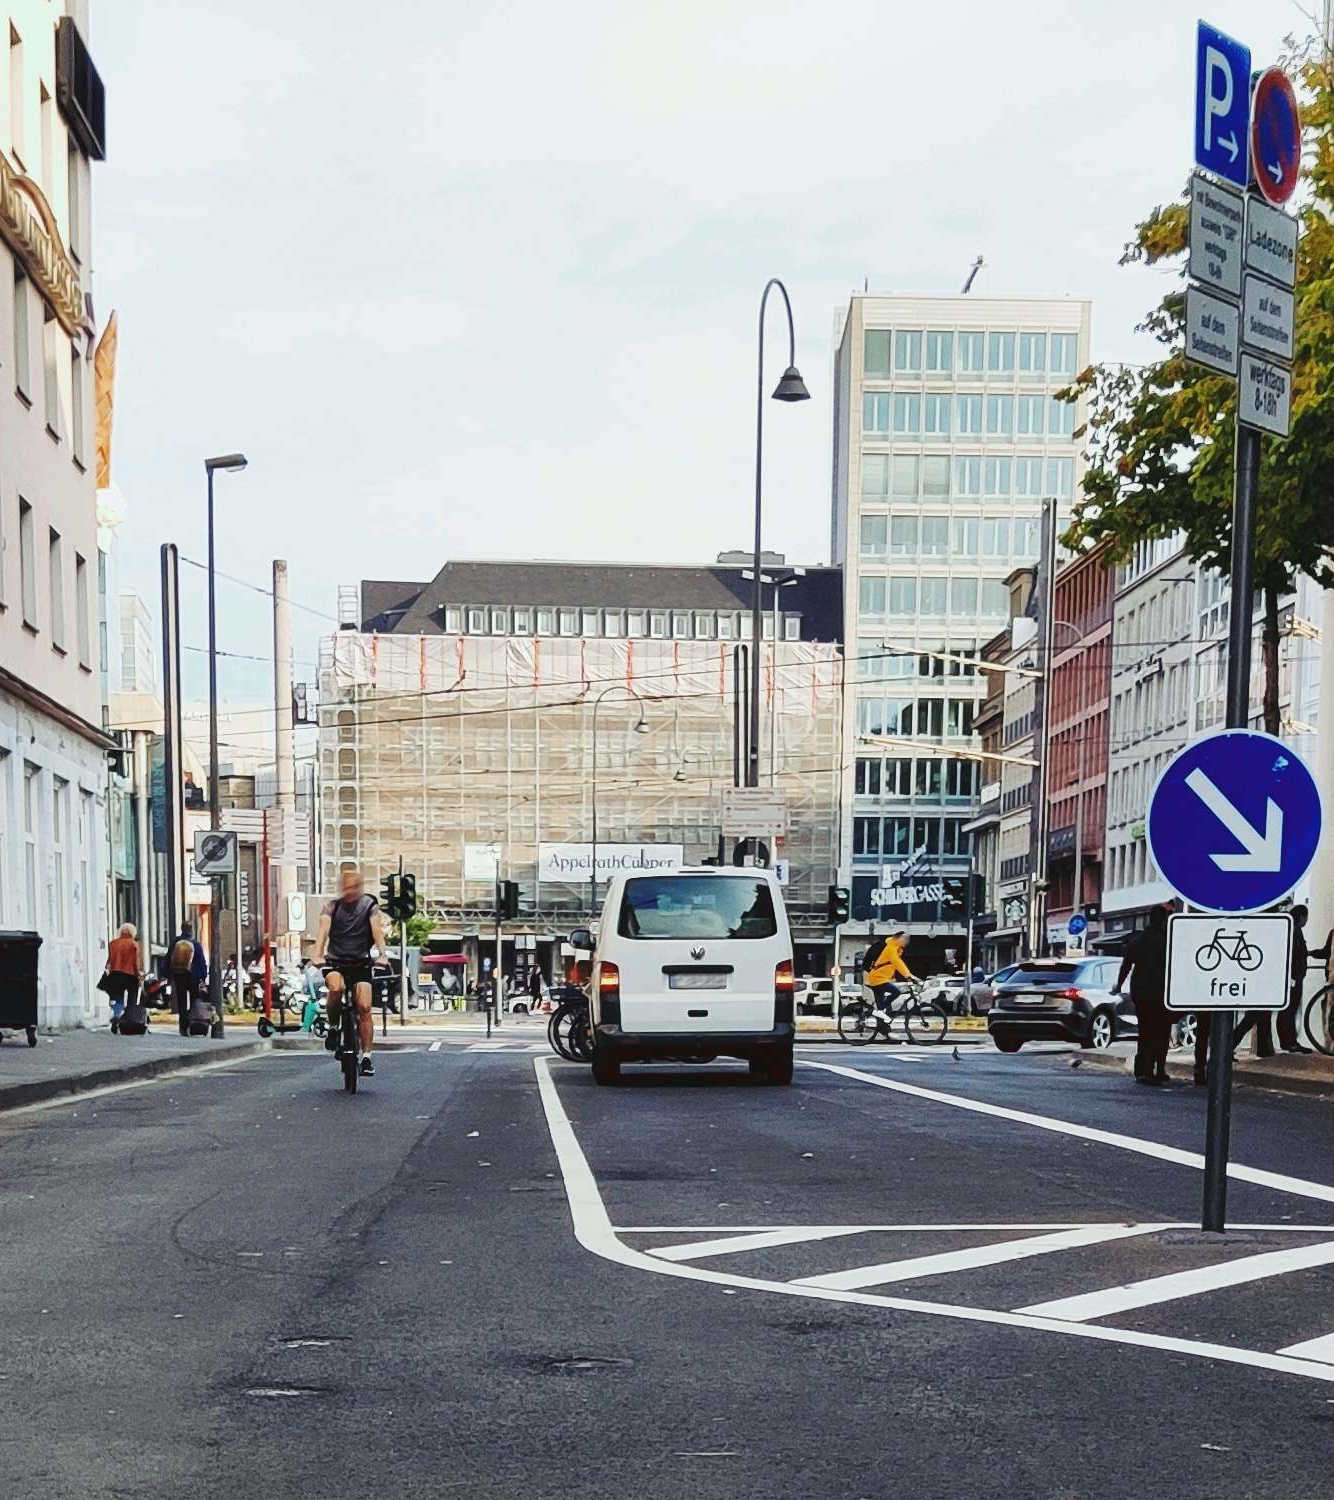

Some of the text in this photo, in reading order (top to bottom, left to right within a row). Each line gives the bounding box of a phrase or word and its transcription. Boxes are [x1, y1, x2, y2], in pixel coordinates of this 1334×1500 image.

[1204, 45, 1234, 151] P
[1250, 222, 1294, 264] Ladezone
[1249, 363, 1286, 399] werktags
[870, 883, 947, 906] SCHILDERGASSE
[1210, 977, 1247, 997] frei
